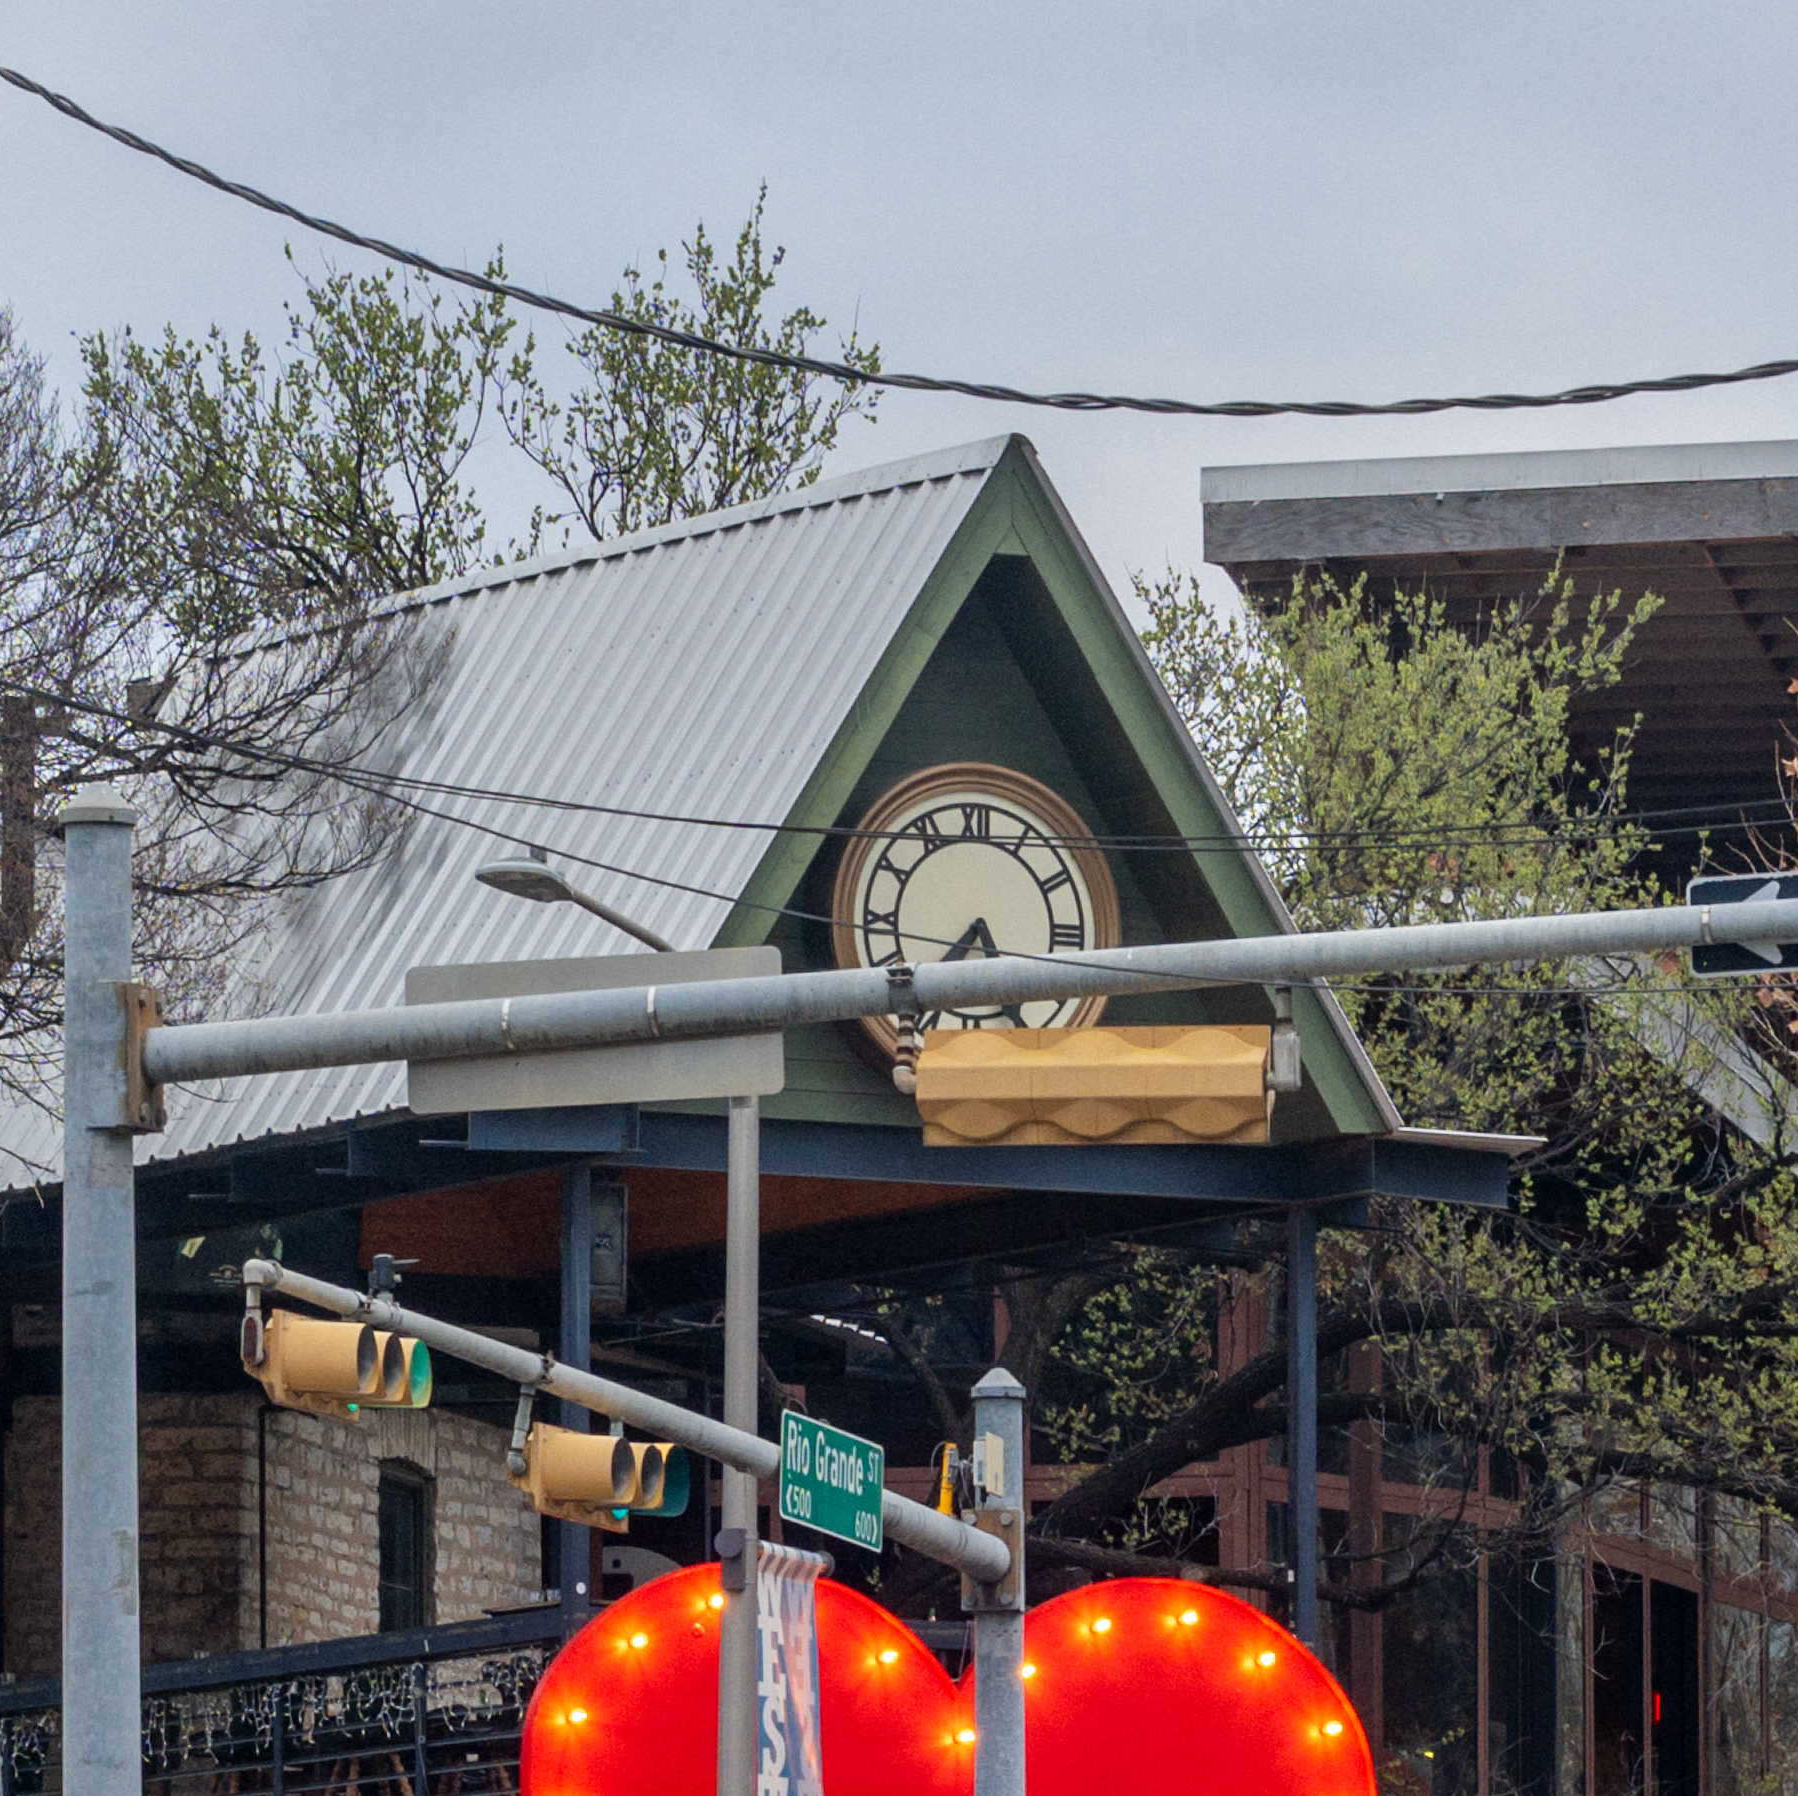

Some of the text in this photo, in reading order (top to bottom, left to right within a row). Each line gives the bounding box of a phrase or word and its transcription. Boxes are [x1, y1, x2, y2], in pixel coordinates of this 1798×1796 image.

[787, 1419, 880, 1496] Rio Grande ST
[793, 1485, 873, 1542] 500 600
